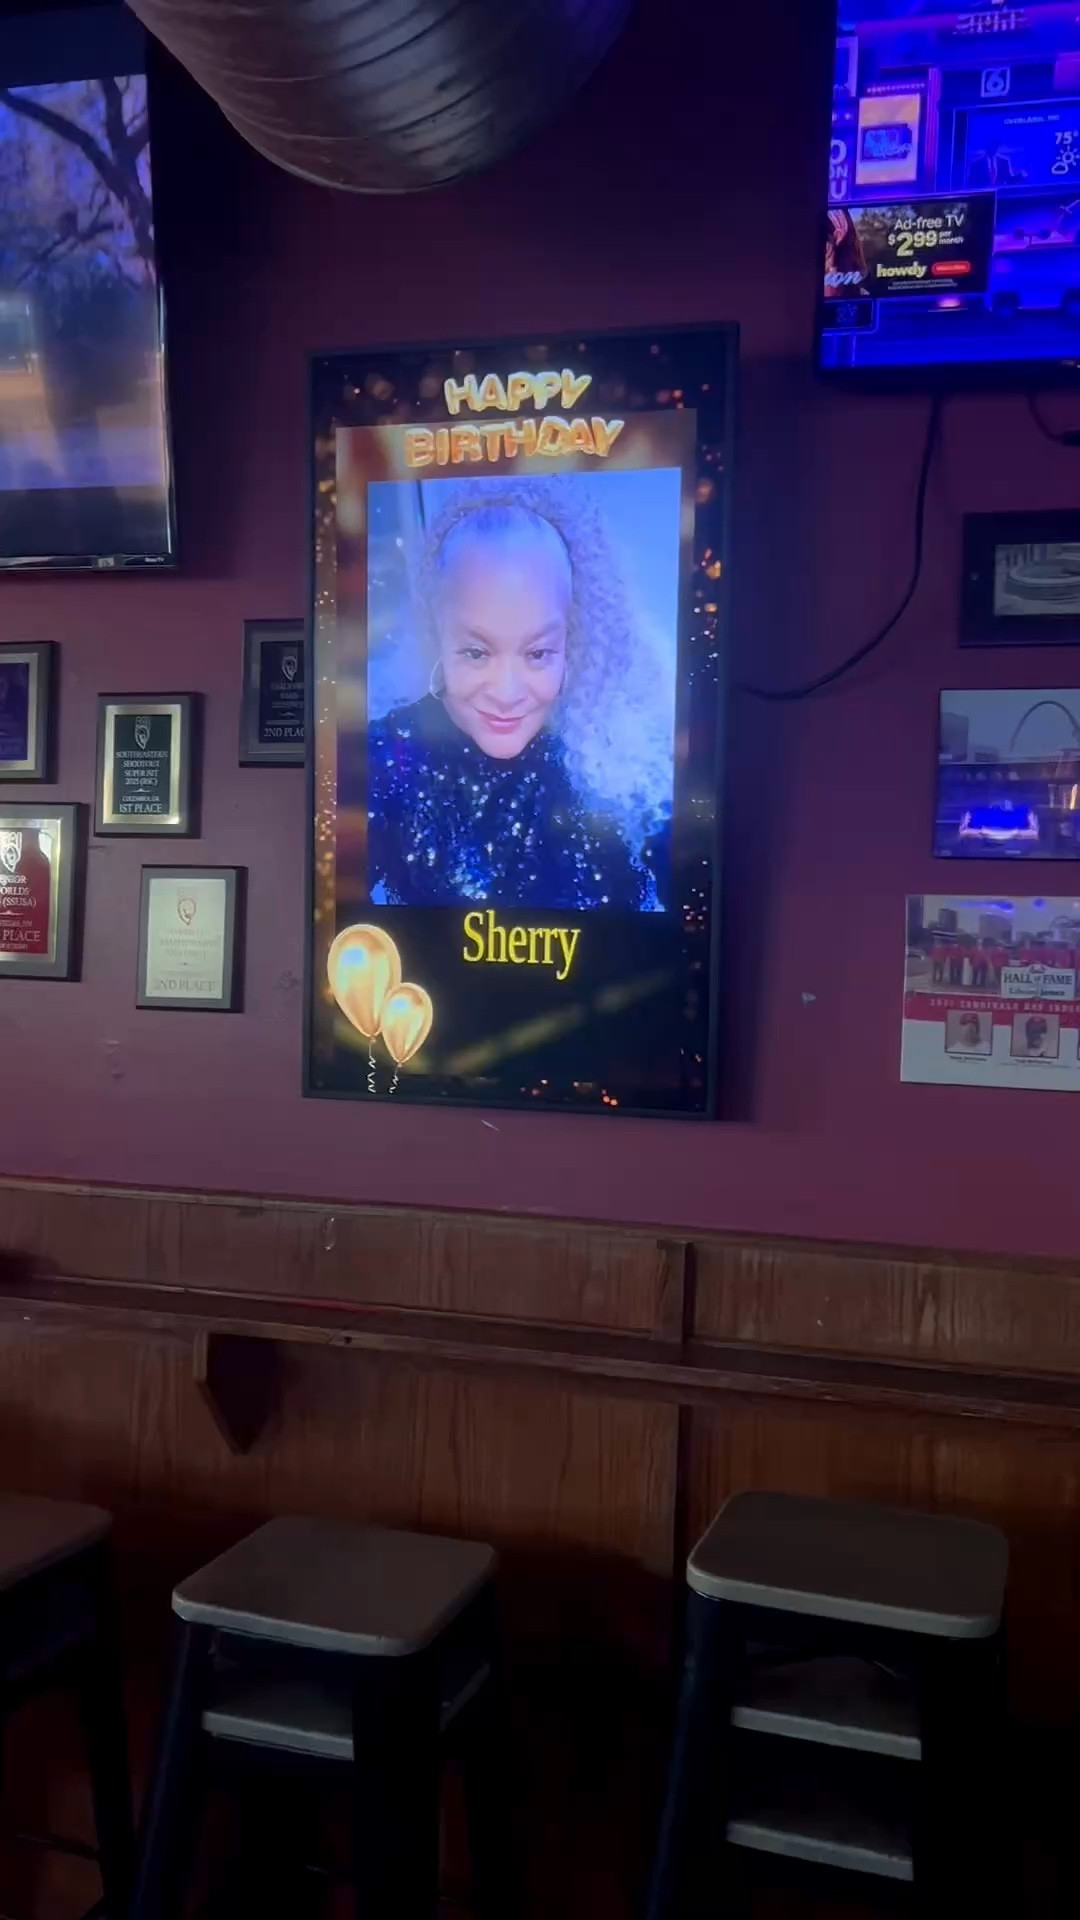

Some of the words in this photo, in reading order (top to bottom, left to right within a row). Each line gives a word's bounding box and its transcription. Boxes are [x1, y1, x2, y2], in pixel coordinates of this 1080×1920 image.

[894, 216, 942, 231] Ad-free
[945, 214, 965, 227] TV
[939, 236, 964, 245] month
[876, 261, 927, 278] howdy
[444, 368, 592, 415] HAPPY
[404, 415, 625, 467] BIRTHDAY
[263, 727, 282, 737] 2ND
[120, 803, 133, 813] 1ST
[134, 803, 163, 813] PLACE
[3, 929, 41, 942] PLACE
[463, 909, 581, 980] Sherry
[153, 978, 178, 991] 2ND
[179, 978, 216, 992] PLACE
[1003, 972, 1033, 984] HALL
[1042, 974, 1073, 985] FAME
